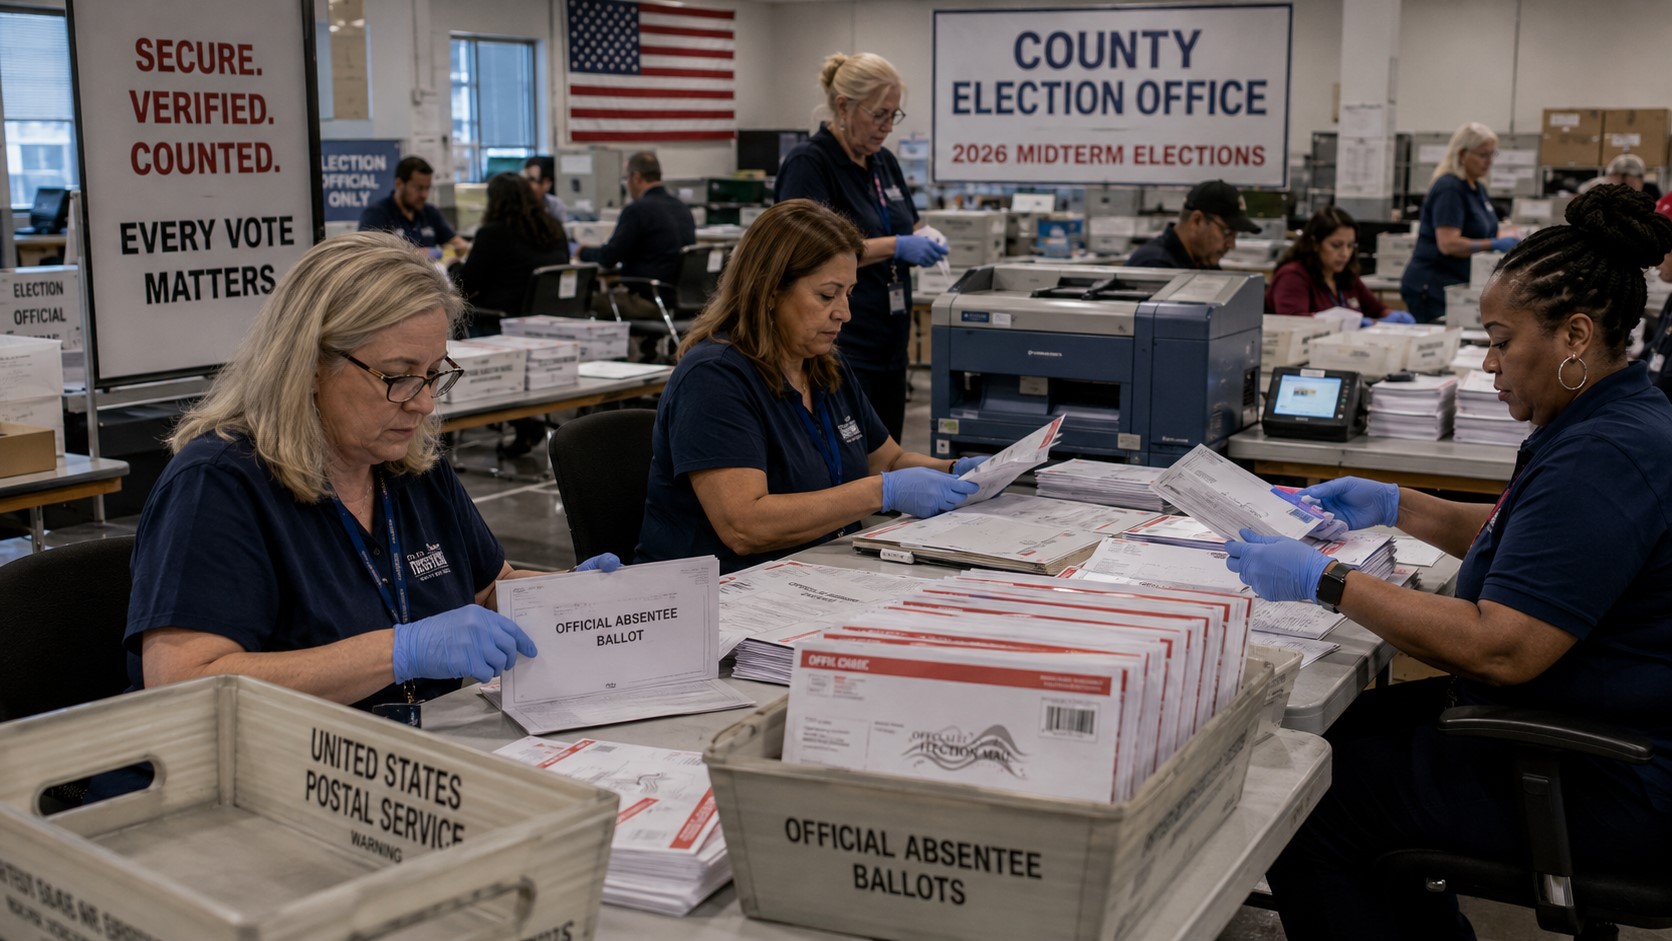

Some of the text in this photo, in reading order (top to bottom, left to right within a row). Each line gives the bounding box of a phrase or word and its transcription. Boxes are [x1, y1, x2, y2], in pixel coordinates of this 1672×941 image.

[135, 37, 263, 76] SECURE.
[1014, 29, 1203, 70] COUNTY
[129, 90, 275, 126] VERIFIED.
[952, 79, 1267, 116] ELECTION OFFICE
[130, 142, 281, 176] COUNTED.
[321, 154, 387, 171] LECTION
[952, 144, 1265, 167] 2026 MIDTERM ELECTIONS
[328, 190, 370, 208] ONLY
[119, 216, 294, 255] EVERY VOTE
[13, 281, 64, 298] ELECTION
[144, 264, 277, 305] MATTERS
[14, 307, 67, 326] OFFICIAL
[555, 617, 613, 634] OFFICIAL
[615, 608, 678, 627] ABSENTEE
[596, 629, 645, 647] BALLOT
[311, 727, 462, 810] UNITED STATES
[306, 769, 465, 850] POSTAL SERVICE
[350, 829, 404, 863] WARNING
[784, 817, 1043, 879] OFFICIAL ABSENTEE
[852, 863, 967, 905] BALLOTS
